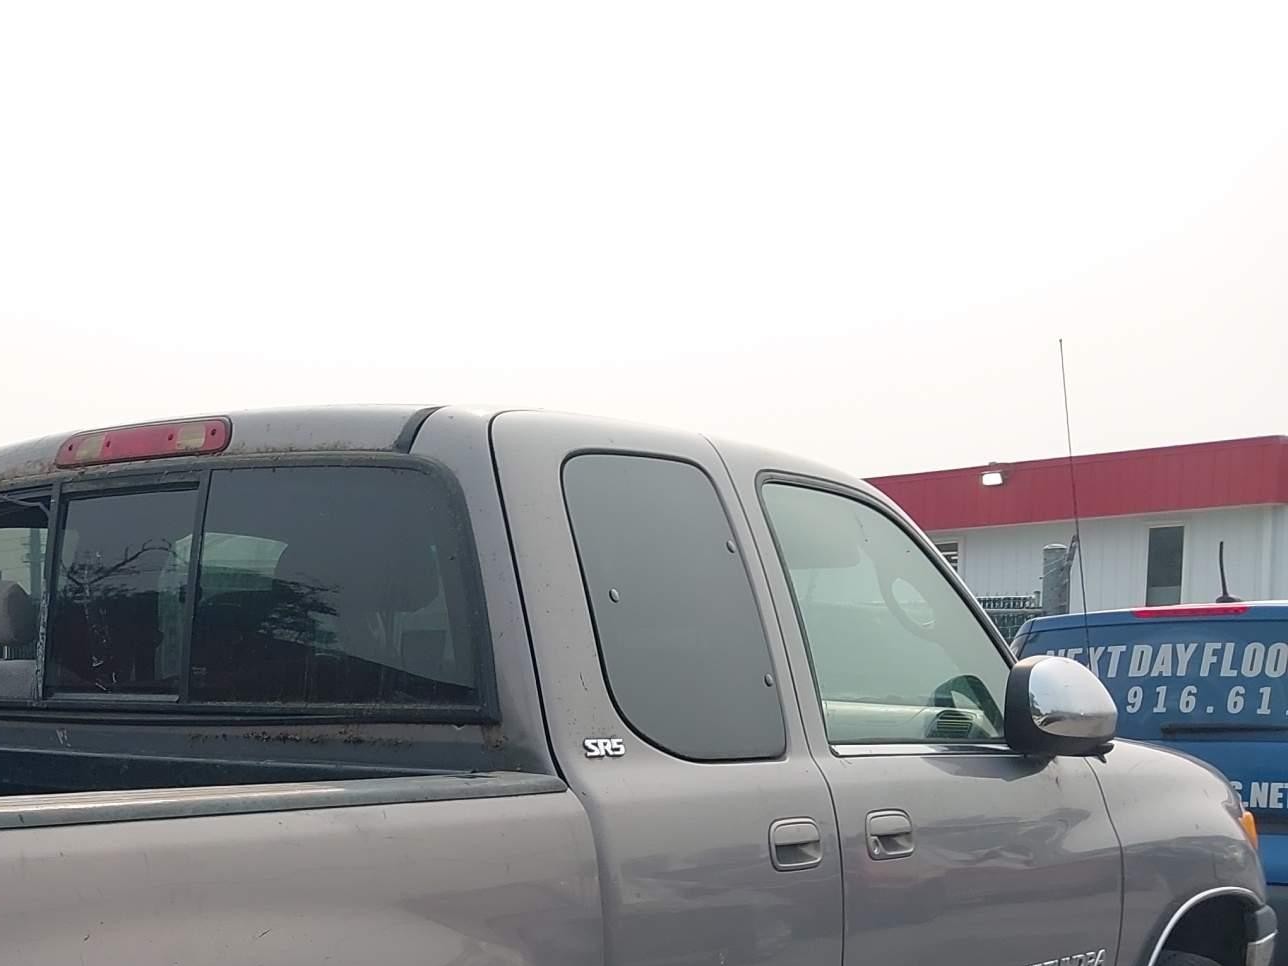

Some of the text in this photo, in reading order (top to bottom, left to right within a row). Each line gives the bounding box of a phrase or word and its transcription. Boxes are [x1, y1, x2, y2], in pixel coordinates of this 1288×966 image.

[1046, 645, 1127, 679] XT
[1128, 643, 1199, 678] DAY
[584, 738, 625, 757] SR5
